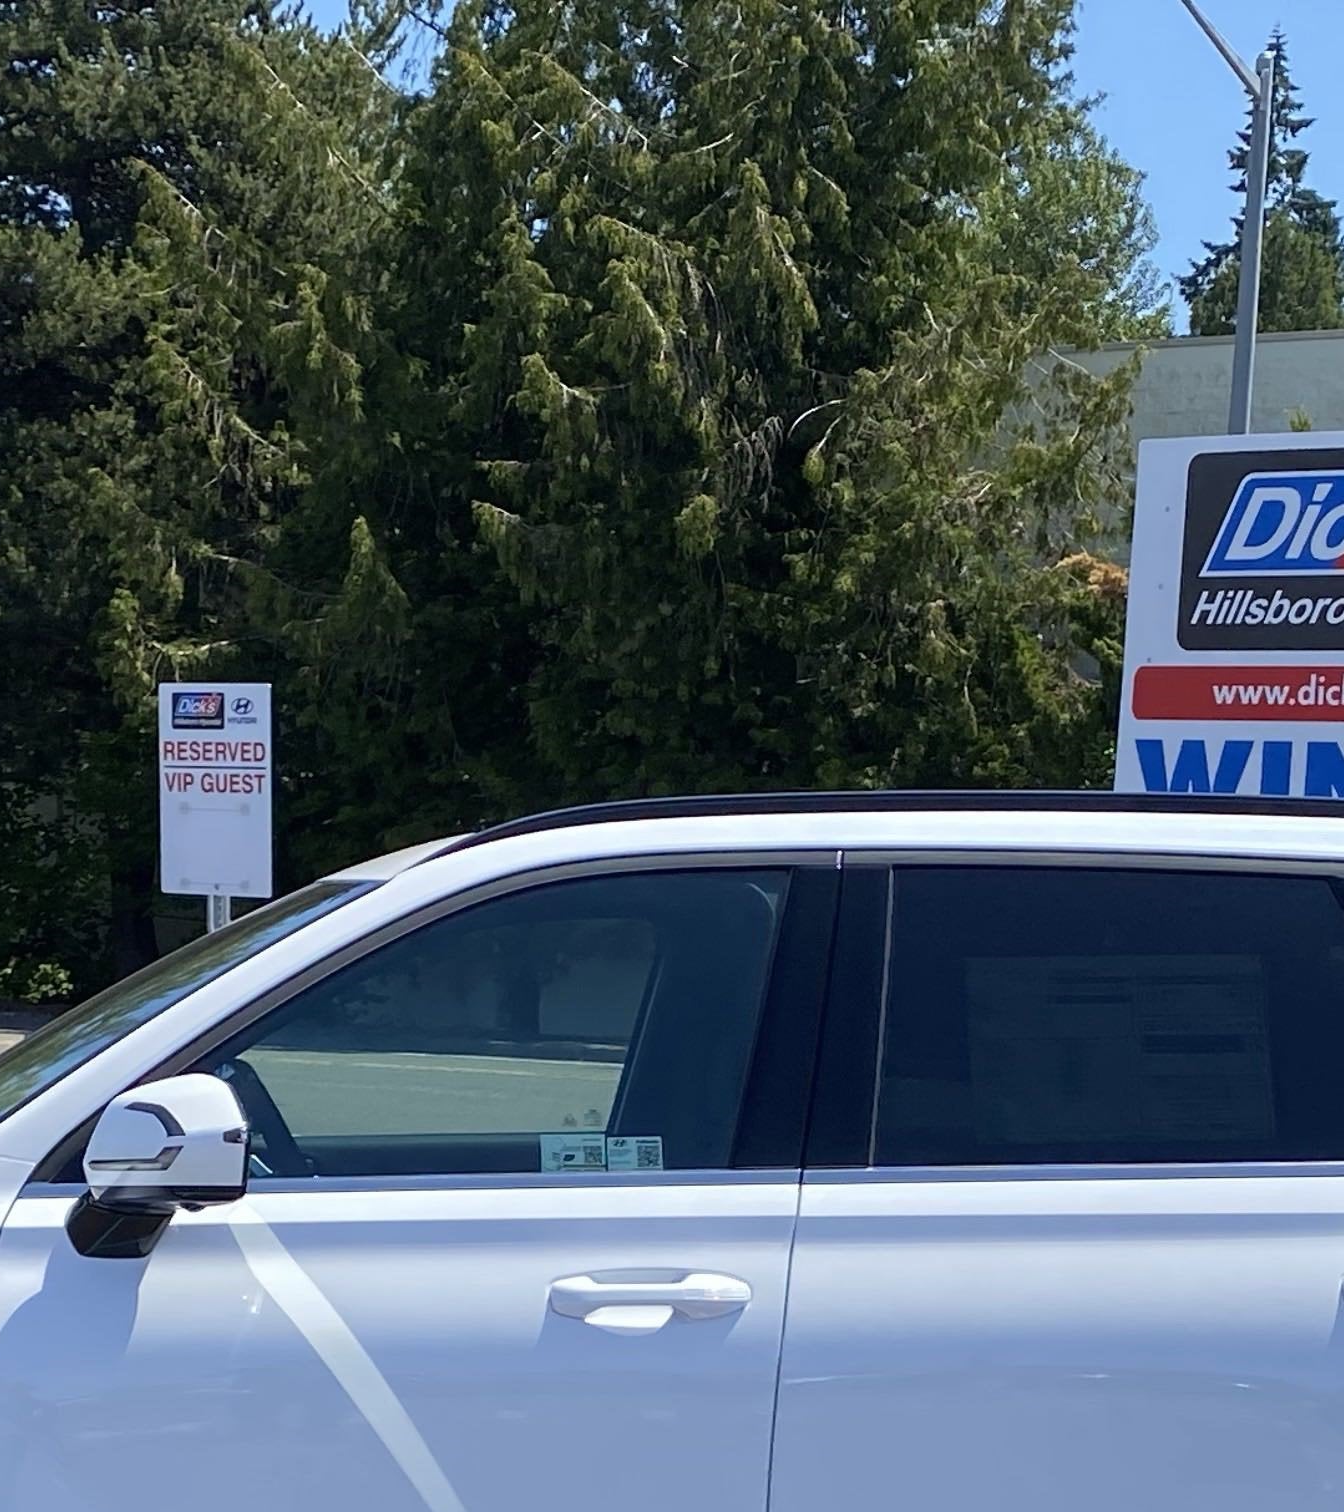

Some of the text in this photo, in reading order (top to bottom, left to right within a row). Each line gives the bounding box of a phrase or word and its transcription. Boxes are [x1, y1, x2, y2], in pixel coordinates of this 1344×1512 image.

[163, 741, 266, 762] RESERVED
[165, 773, 266, 794] VIP GUEST
